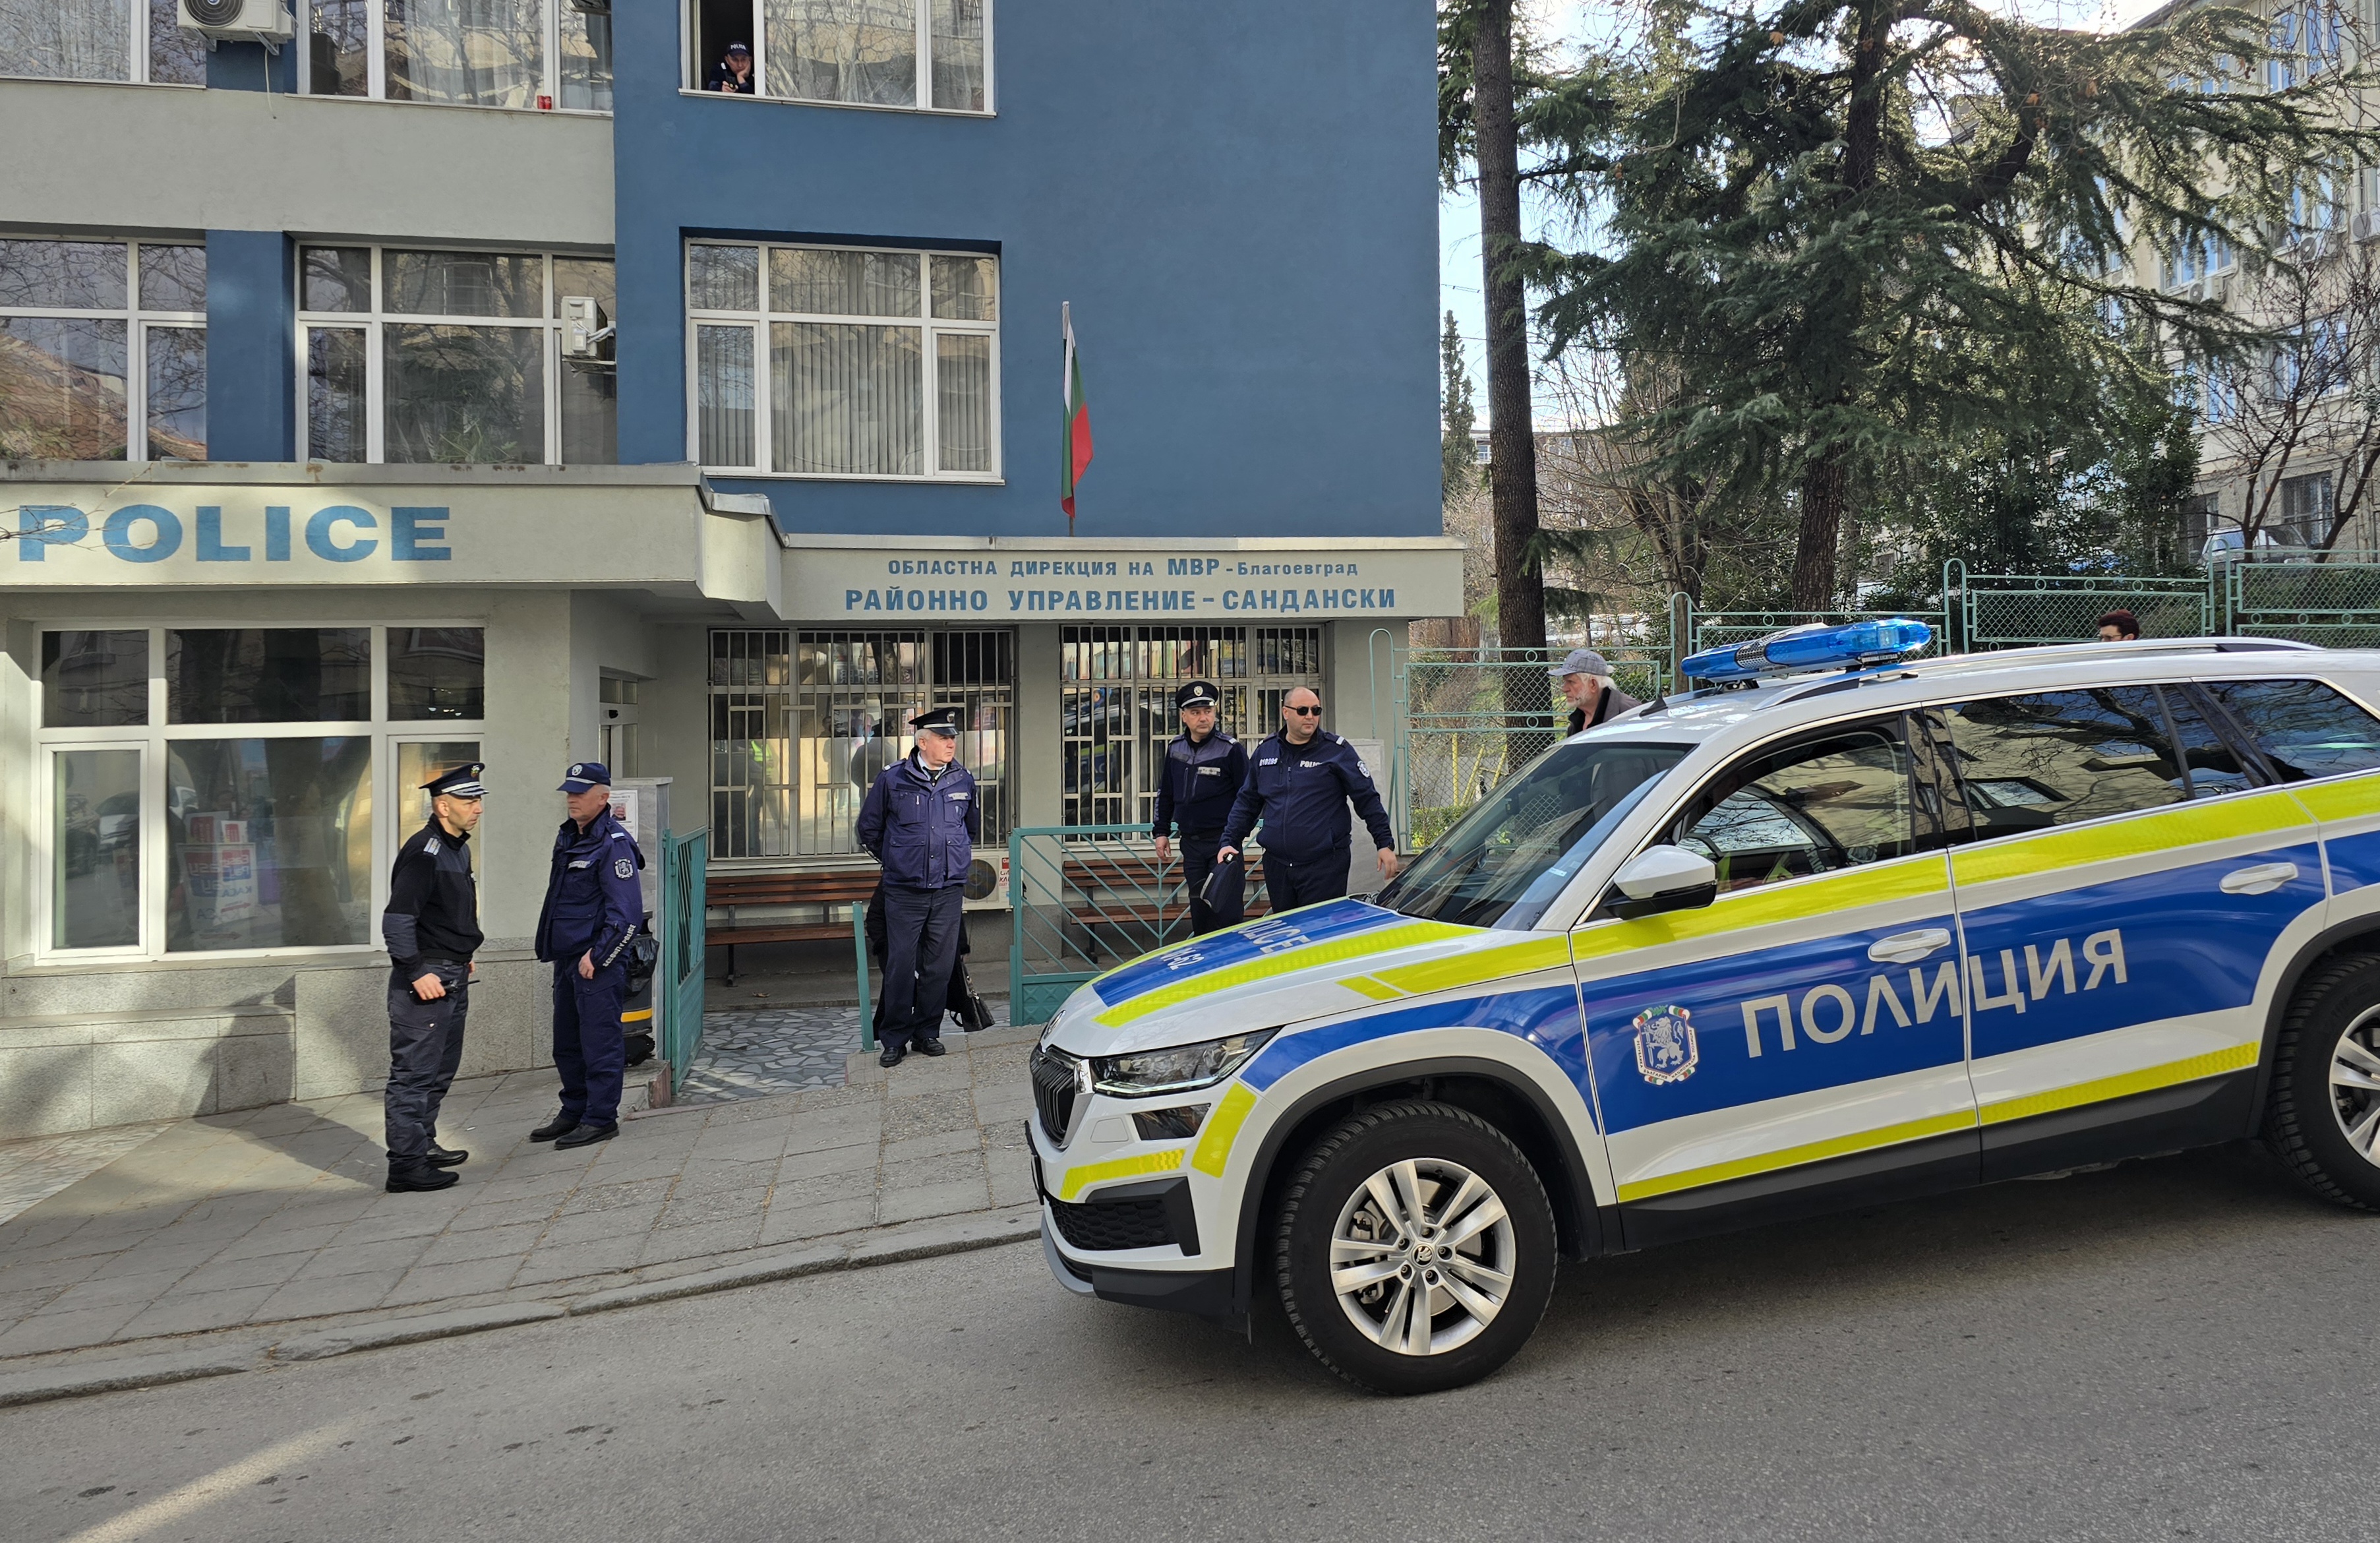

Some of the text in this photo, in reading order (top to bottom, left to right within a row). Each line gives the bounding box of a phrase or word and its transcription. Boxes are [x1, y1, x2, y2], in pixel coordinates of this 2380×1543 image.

[19, 504, 452, 562] POLICE
[888, 560, 997, 575] ОБЛАСТНА
[1010, 560, 1117, 577] ДИРЕКЦИЯ
[1129, 562, 1154, 576] НА
[1167, 559, 1220, 576] МВР
[845, 586, 988, 611] РАЙОННО
[1008, 590, 1195, 611] УПРАВЛЕНИЕ
[1222, 589, 1395, 613] САНДАНСКИ
[1232, 919, 1311, 954] OLICE
[1740, 928, 2127, 1058] ПОЛИЦИЯ
